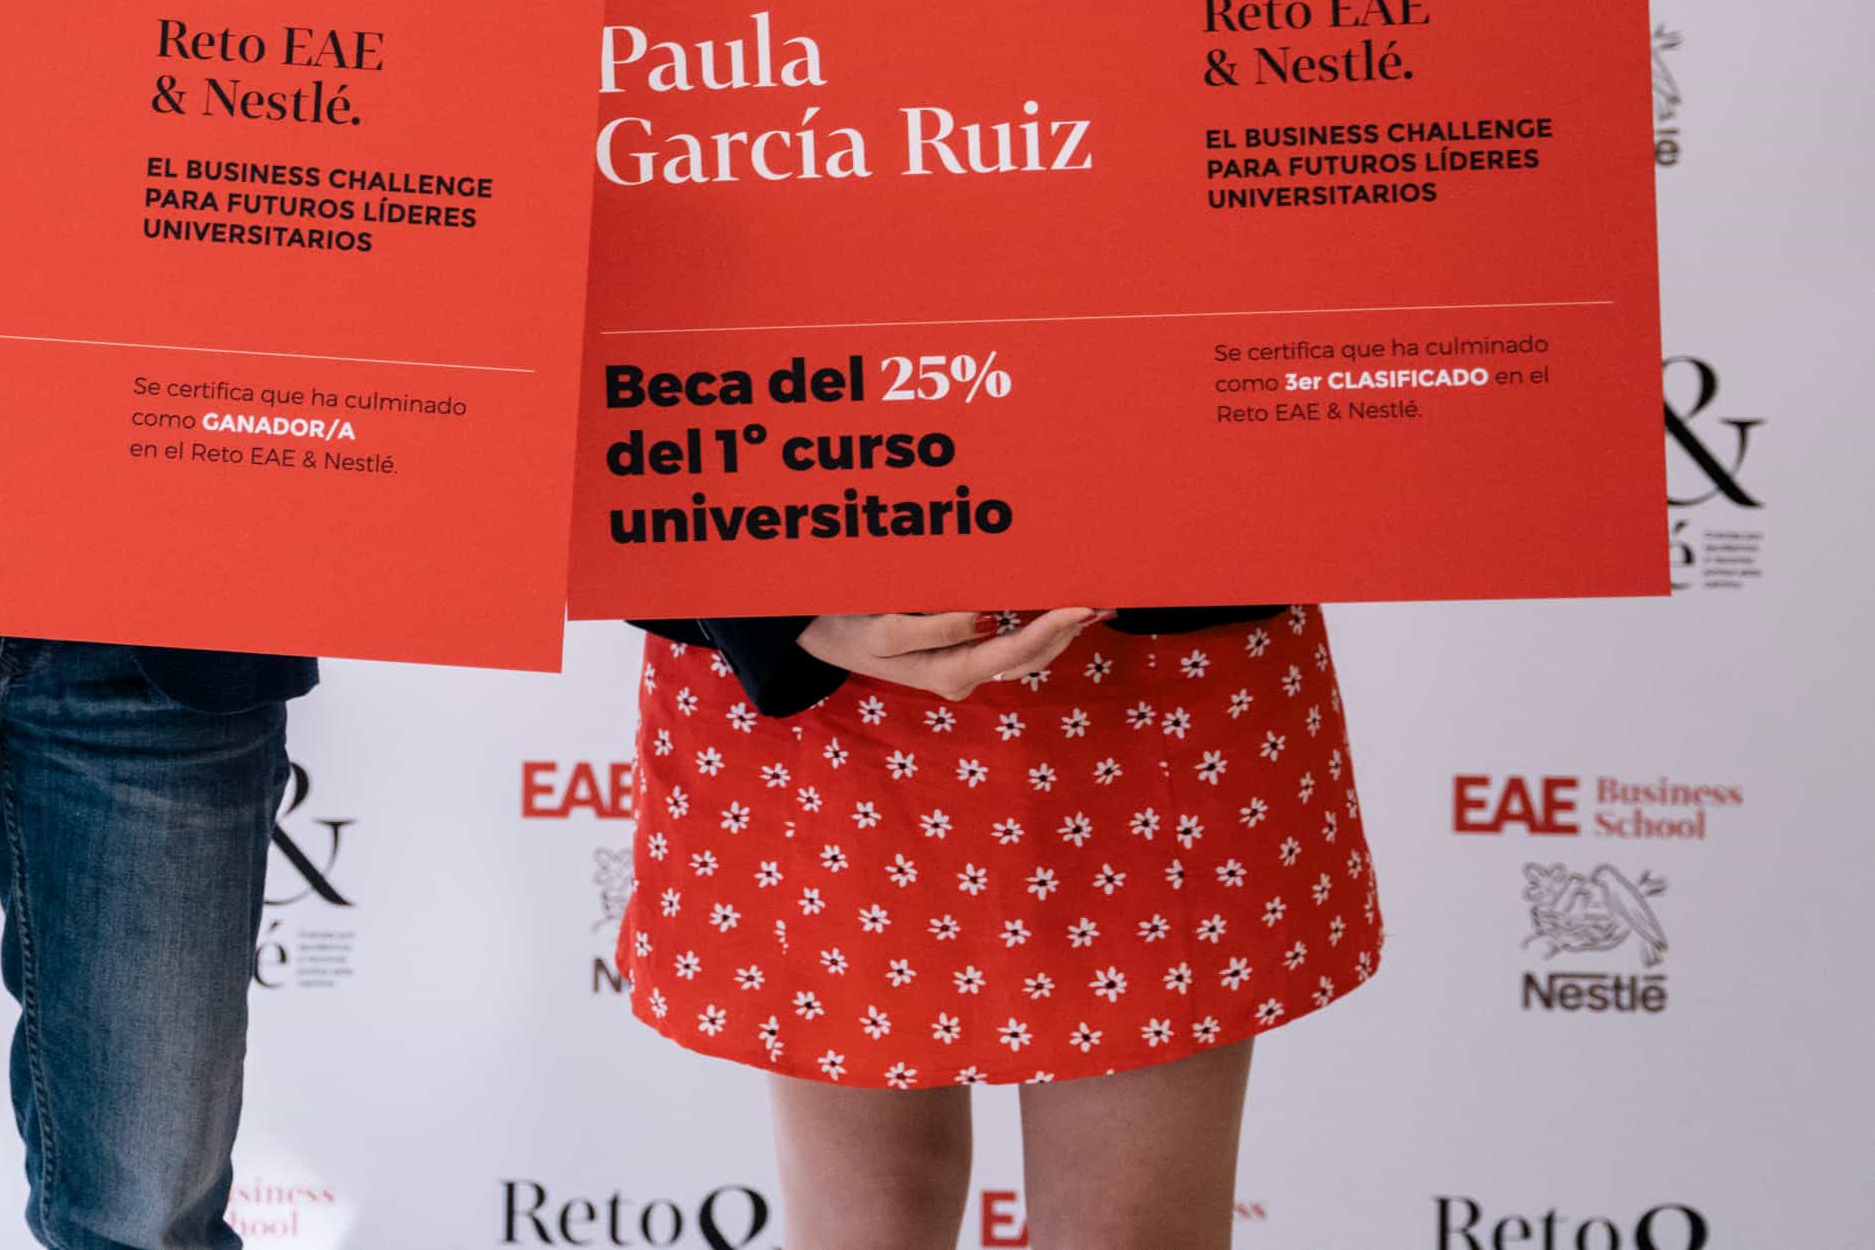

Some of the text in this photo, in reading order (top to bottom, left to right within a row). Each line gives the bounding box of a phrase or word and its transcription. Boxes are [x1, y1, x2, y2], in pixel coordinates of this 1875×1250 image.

[157, 19, 384, 71] Reto EAE
[599, 12, 827, 93] Paula
[1203, 40, 1413, 87] & Nestlé.
[151, 75, 361, 125] & Nestlé.
[596, 100, 1092, 186] García Ruiz
[1206, 119, 1553, 149] EL BUSINESS CHALLENGE
[147, 158, 493, 199] EL BUSINESS CHALLENGE
[1208, 146, 1539, 179] PARA FUTUROS LÍDERES
[145, 189, 477, 228] PARA FUTUROS LÍDERES
[1209, 183, 1437, 208] UNIVERSITARIOS
[143, 219, 372, 252] UNIVERSITARIOS
[1215, 335, 1548, 363] Se certifica que ha culminado
[133, 377, 466, 416] Se certifica que ha culminado
[606, 350, 1011, 408] Beca del 25%
[1215, 366, 1548, 393] como 3er CLASIFICADO en el
[132, 411, 356, 440] como GANADOR/A
[1217, 399, 1422, 423] Reto EAE & Nestlé.
[130, 441, 397, 475] en el Reto EAE & Nestlé.
[607, 428, 701, 475] del
[783, 431, 955, 471] curso
[610, 485, 1012, 543] universitario
[1454, 776, 1743, 835] EAE Business
[1595, 812, 1707, 840] School
[1522, 972, 1666, 1012] Nestlé
[499, 1179, 683, 1246] Reto
